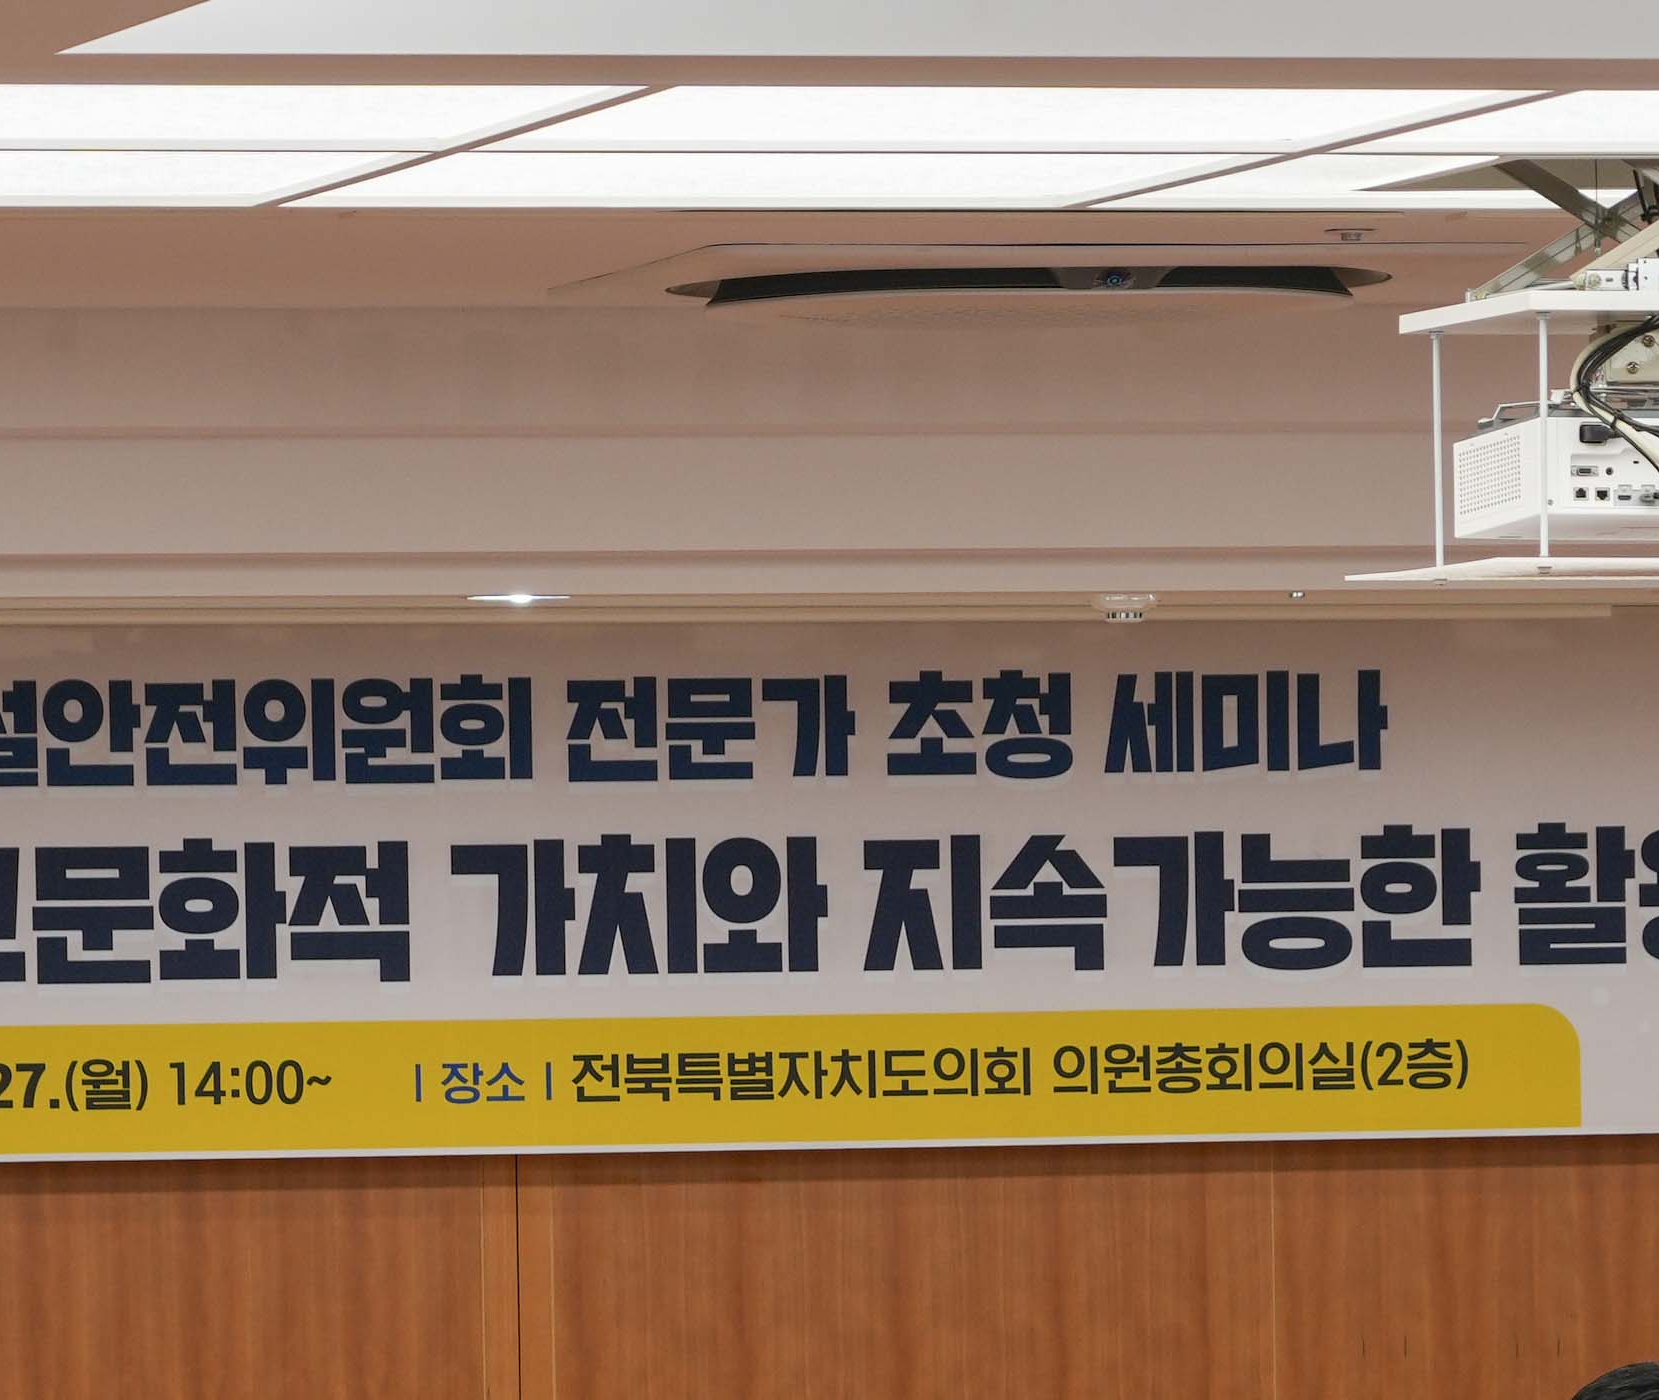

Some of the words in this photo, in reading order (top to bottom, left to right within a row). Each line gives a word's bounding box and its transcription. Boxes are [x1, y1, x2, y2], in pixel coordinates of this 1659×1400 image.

[566, 674, 856, 782] 전문가
[887, 669, 1073, 778] 초청
[1104, 670, 1388, 773] 세미나
[451, 834, 828, 977] 가치와
[863, 825, 1482, 972] 지속가능한
[169, 1058, 333, 1107] 14:00~
[440, 1060, 526, 1105] 장소
[571, 1046, 1033, 1104] 전북특별자치도의회
[1053, 1039, 1470, 1097] 의원총회의실(2층)
